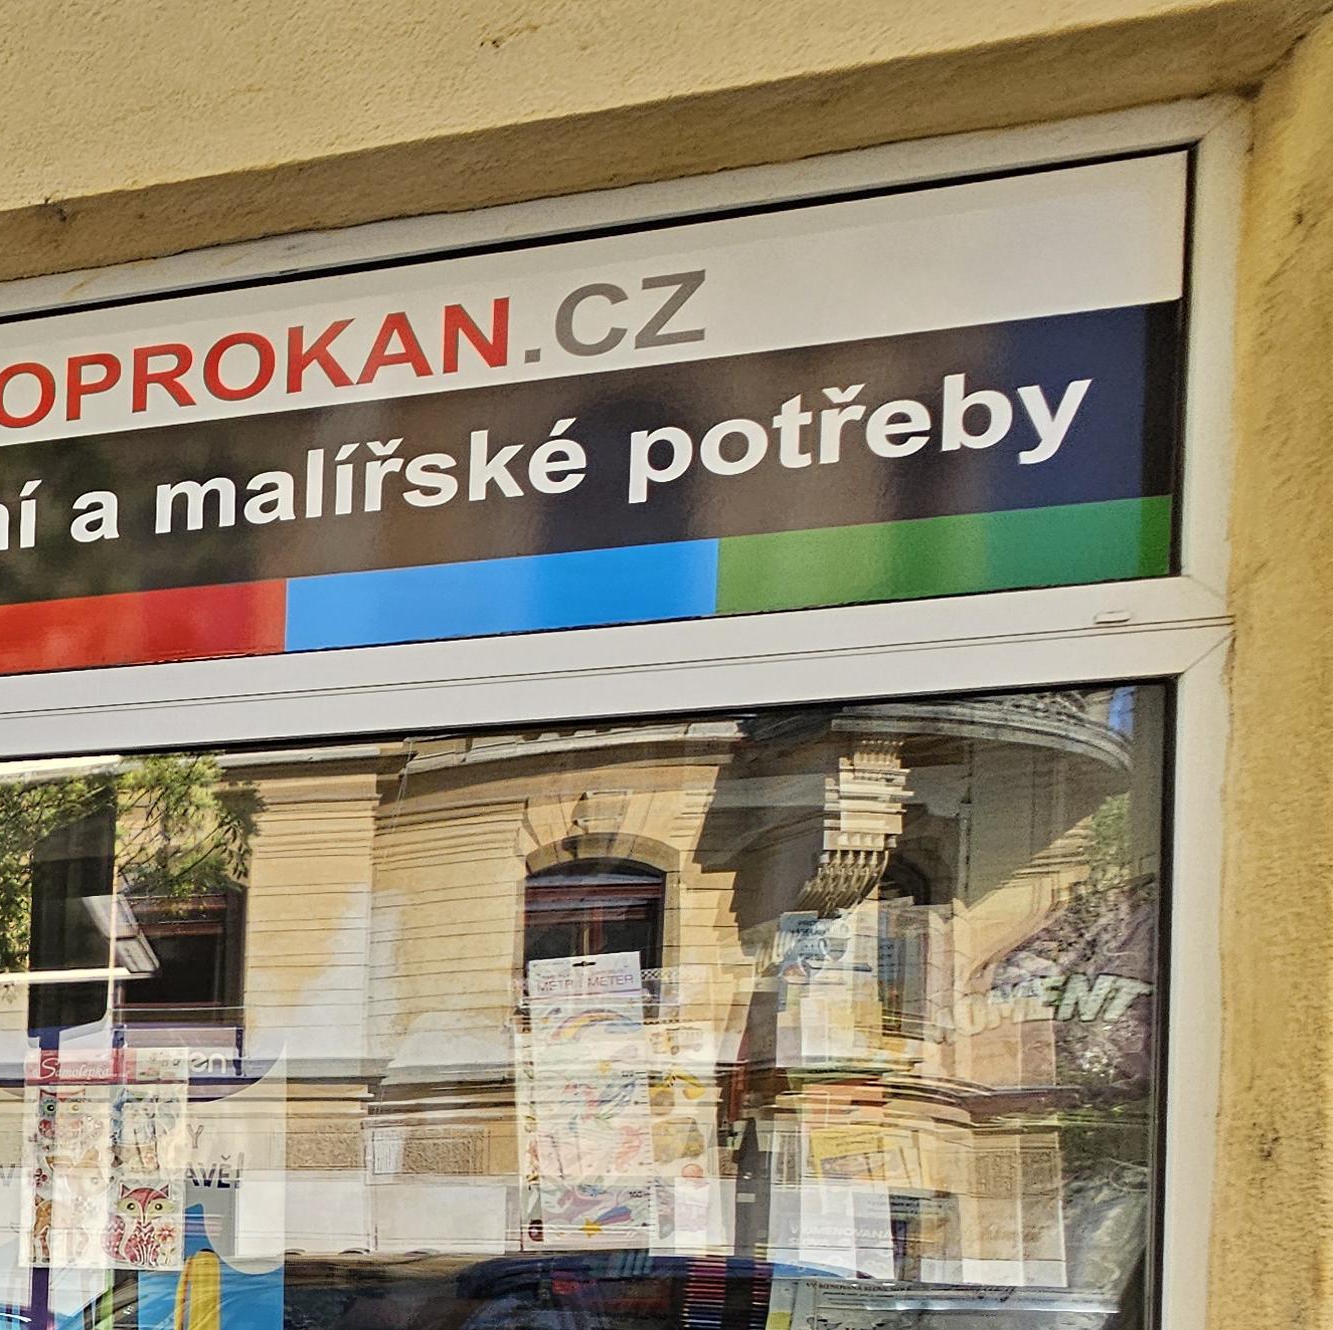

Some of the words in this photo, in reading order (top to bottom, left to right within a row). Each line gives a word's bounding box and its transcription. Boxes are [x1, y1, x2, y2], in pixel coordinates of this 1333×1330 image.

[70, 489, 119, 543] a
[155, 418, 585, 535] malířské
[629, 373, 1093, 505] potřeby
